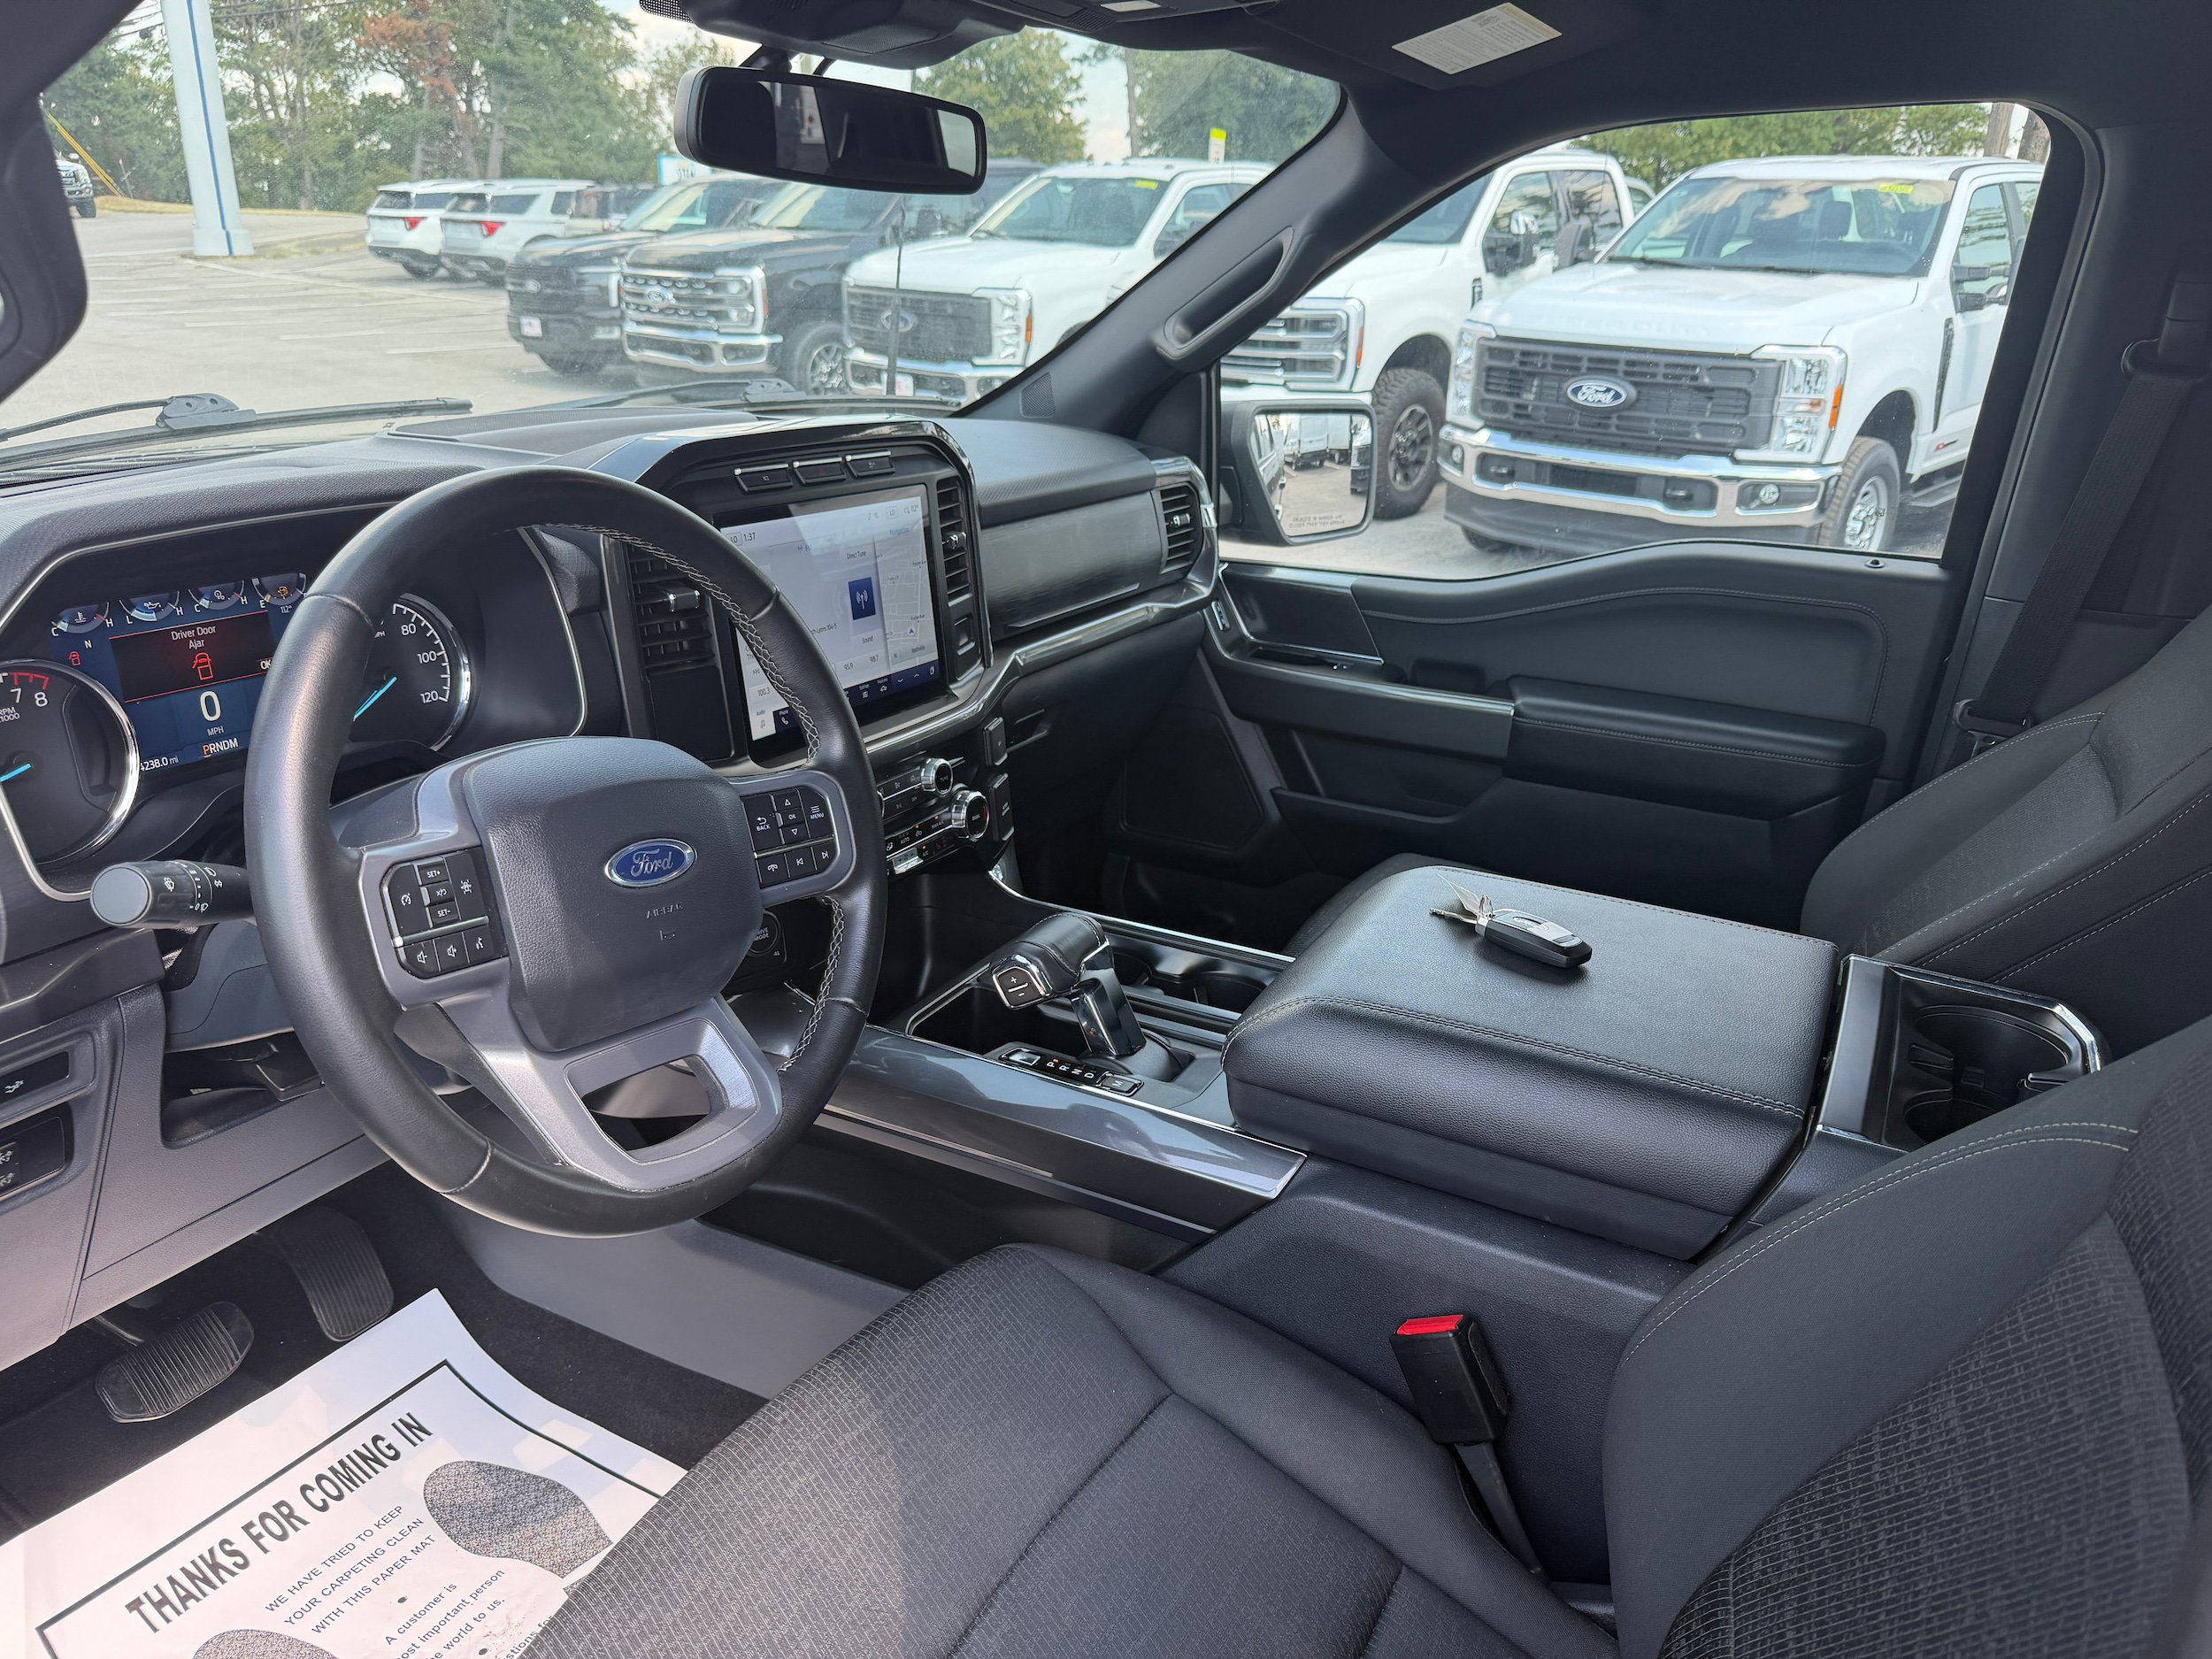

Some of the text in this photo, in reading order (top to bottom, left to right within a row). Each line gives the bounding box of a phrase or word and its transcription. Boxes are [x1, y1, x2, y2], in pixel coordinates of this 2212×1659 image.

[1578, 383, 1616, 403] Ford
[171, 625, 217, 641] Driver Door
[401, 623, 417, 636] 80
[188, 638, 205, 650] Ajar
[260, 659, 271, 670] OK
[417, 650, 437, 664] 100
[10, 687, 22, 703] 7
[35, 692, 49, 707] 8
[420, 690, 439, 703] 120
[199, 690, 221, 722] 0
[207, 726, 225, 736] MPH
[630, 849, 673, 878] Ford
[125, 1411, 434, 1634] THANKS FOR COMING IN
[265, 1505, 403, 1612] WE HAVE TRIED TO KEEP
[284, 1517, 425, 1626] YOUR CARPETING CLEAN
[311, 1534, 437, 1634] WITH THIS PAPER MAT
[385, 1582, 457, 1646] A customer is
[397, 1569, 506, 1659] ost important person
[443, 1598, 505, 1650] world to us.
